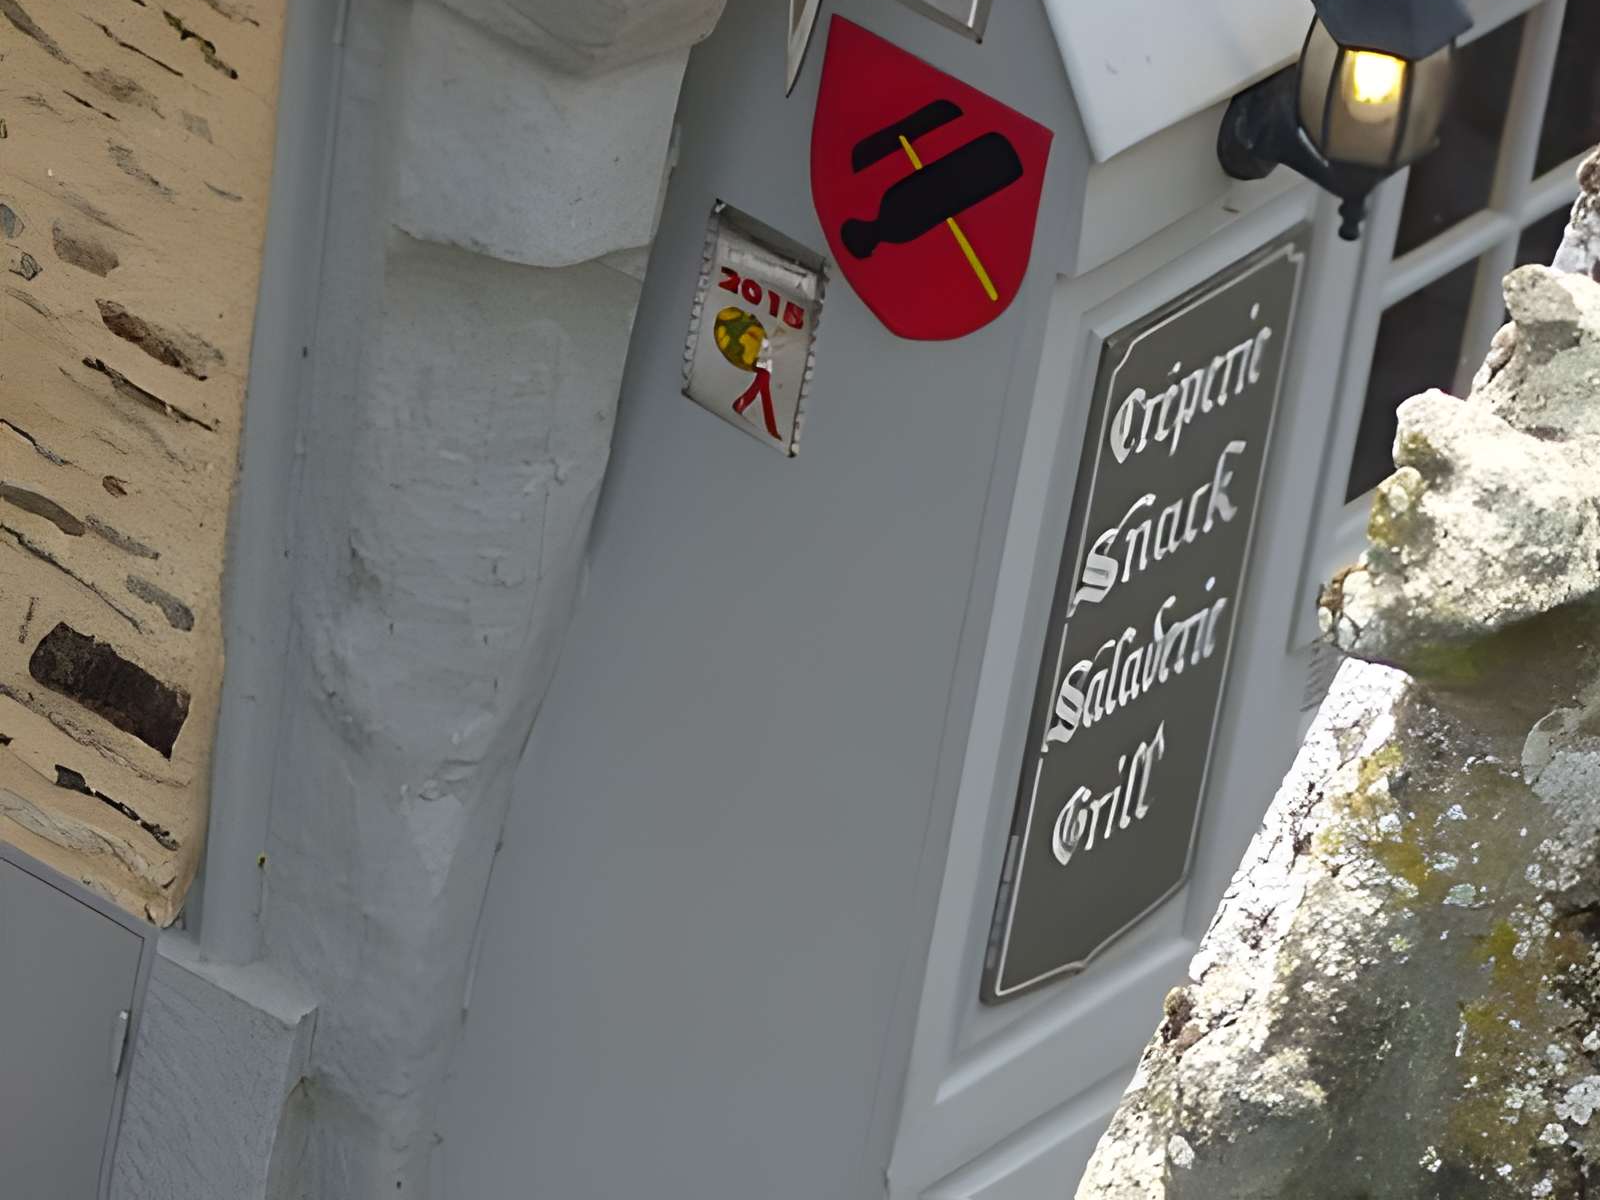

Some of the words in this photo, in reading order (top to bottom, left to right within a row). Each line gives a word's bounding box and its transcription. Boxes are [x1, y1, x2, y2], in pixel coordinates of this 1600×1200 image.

[1066, 440, 1247, 618] Snack
[1041, 577, 1227, 753] Saladerie
[1052, 719, 1165, 866] Grill
